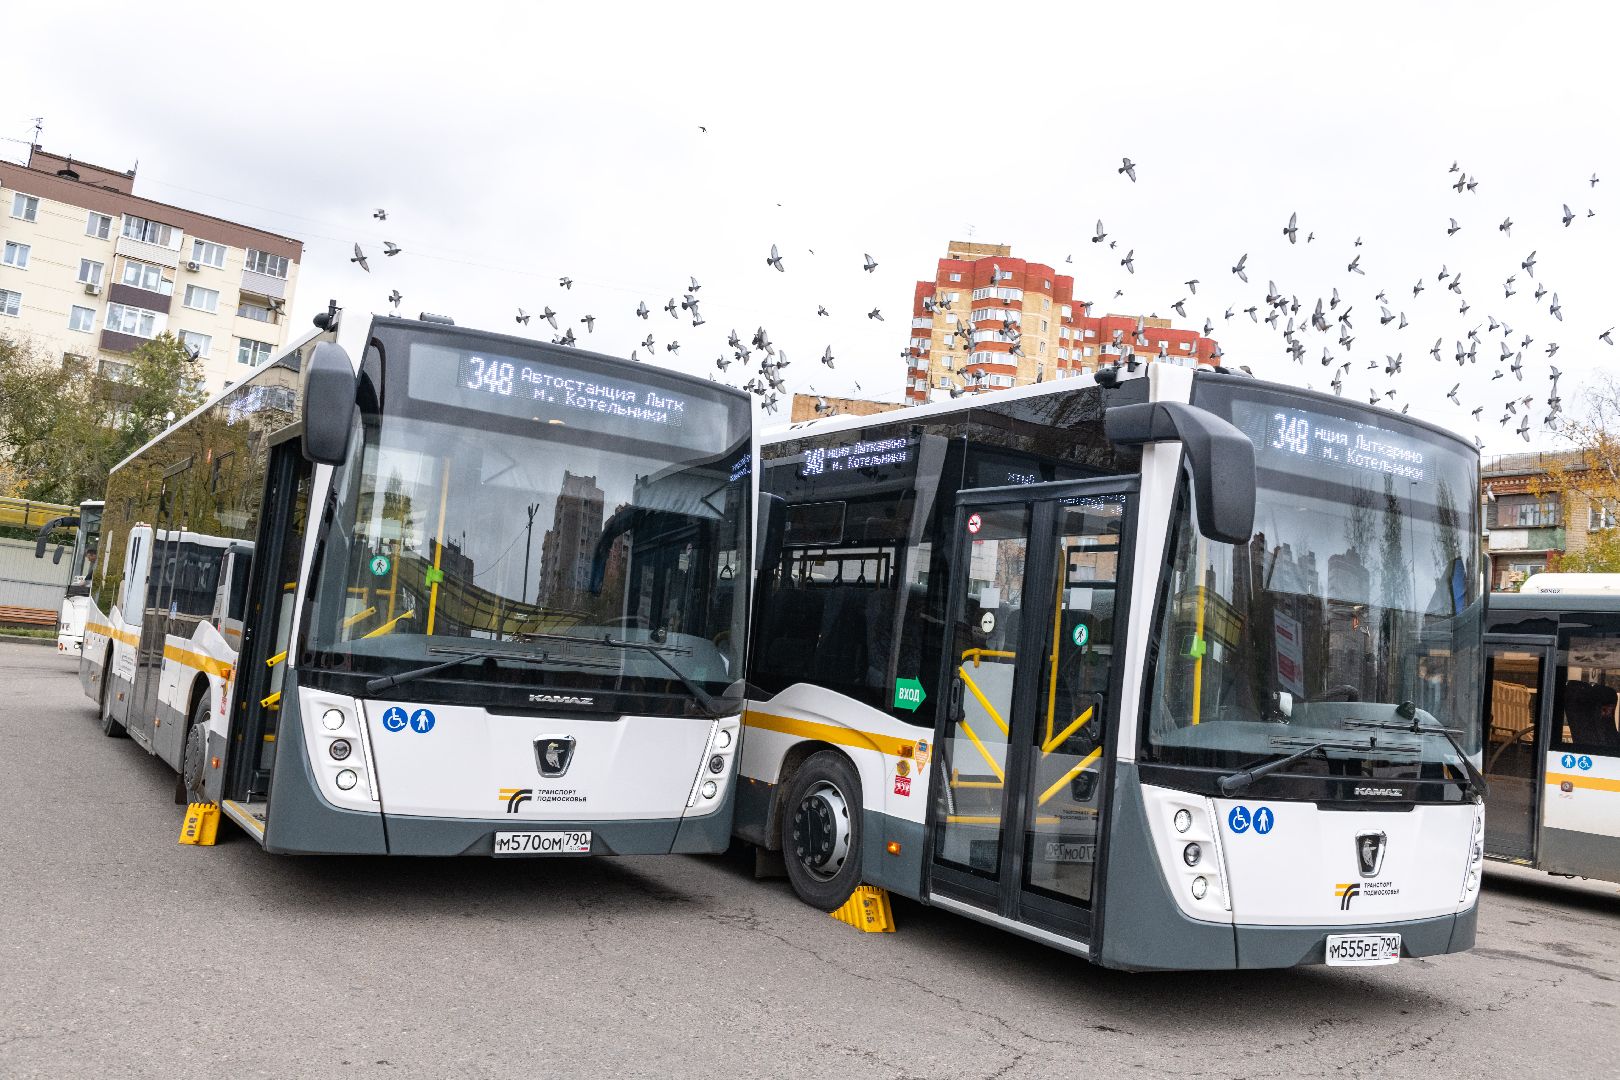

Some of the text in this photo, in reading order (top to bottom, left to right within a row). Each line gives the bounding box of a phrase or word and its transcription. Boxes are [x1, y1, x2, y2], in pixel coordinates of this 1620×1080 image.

[467, 356, 515, 396] 348
[521, 367, 685, 412] Автостанция Лытк
[565, 389, 667, 423] Котельники
[1272, 413, 1309, 454] 348
[1315, 427, 1423, 464] нция Лыткарино
[802, 447, 824, 476] 348
[847, 451, 907, 469] Котельники
[1347, 449, 1423, 480] Котельники
[528, 694, 594, 705] KAMAZ
[898, 687, 920, 702] ВХОД
[537, 795, 587, 803] ПОДМОСКОВЬЯ
[1354, 787, 1403, 797] KAMAZ
[1363, 888, 1400, 897] ПОДМОСКОВЬЯ
[1364, 881, 1392, 889] ТРАНСПОРТ
